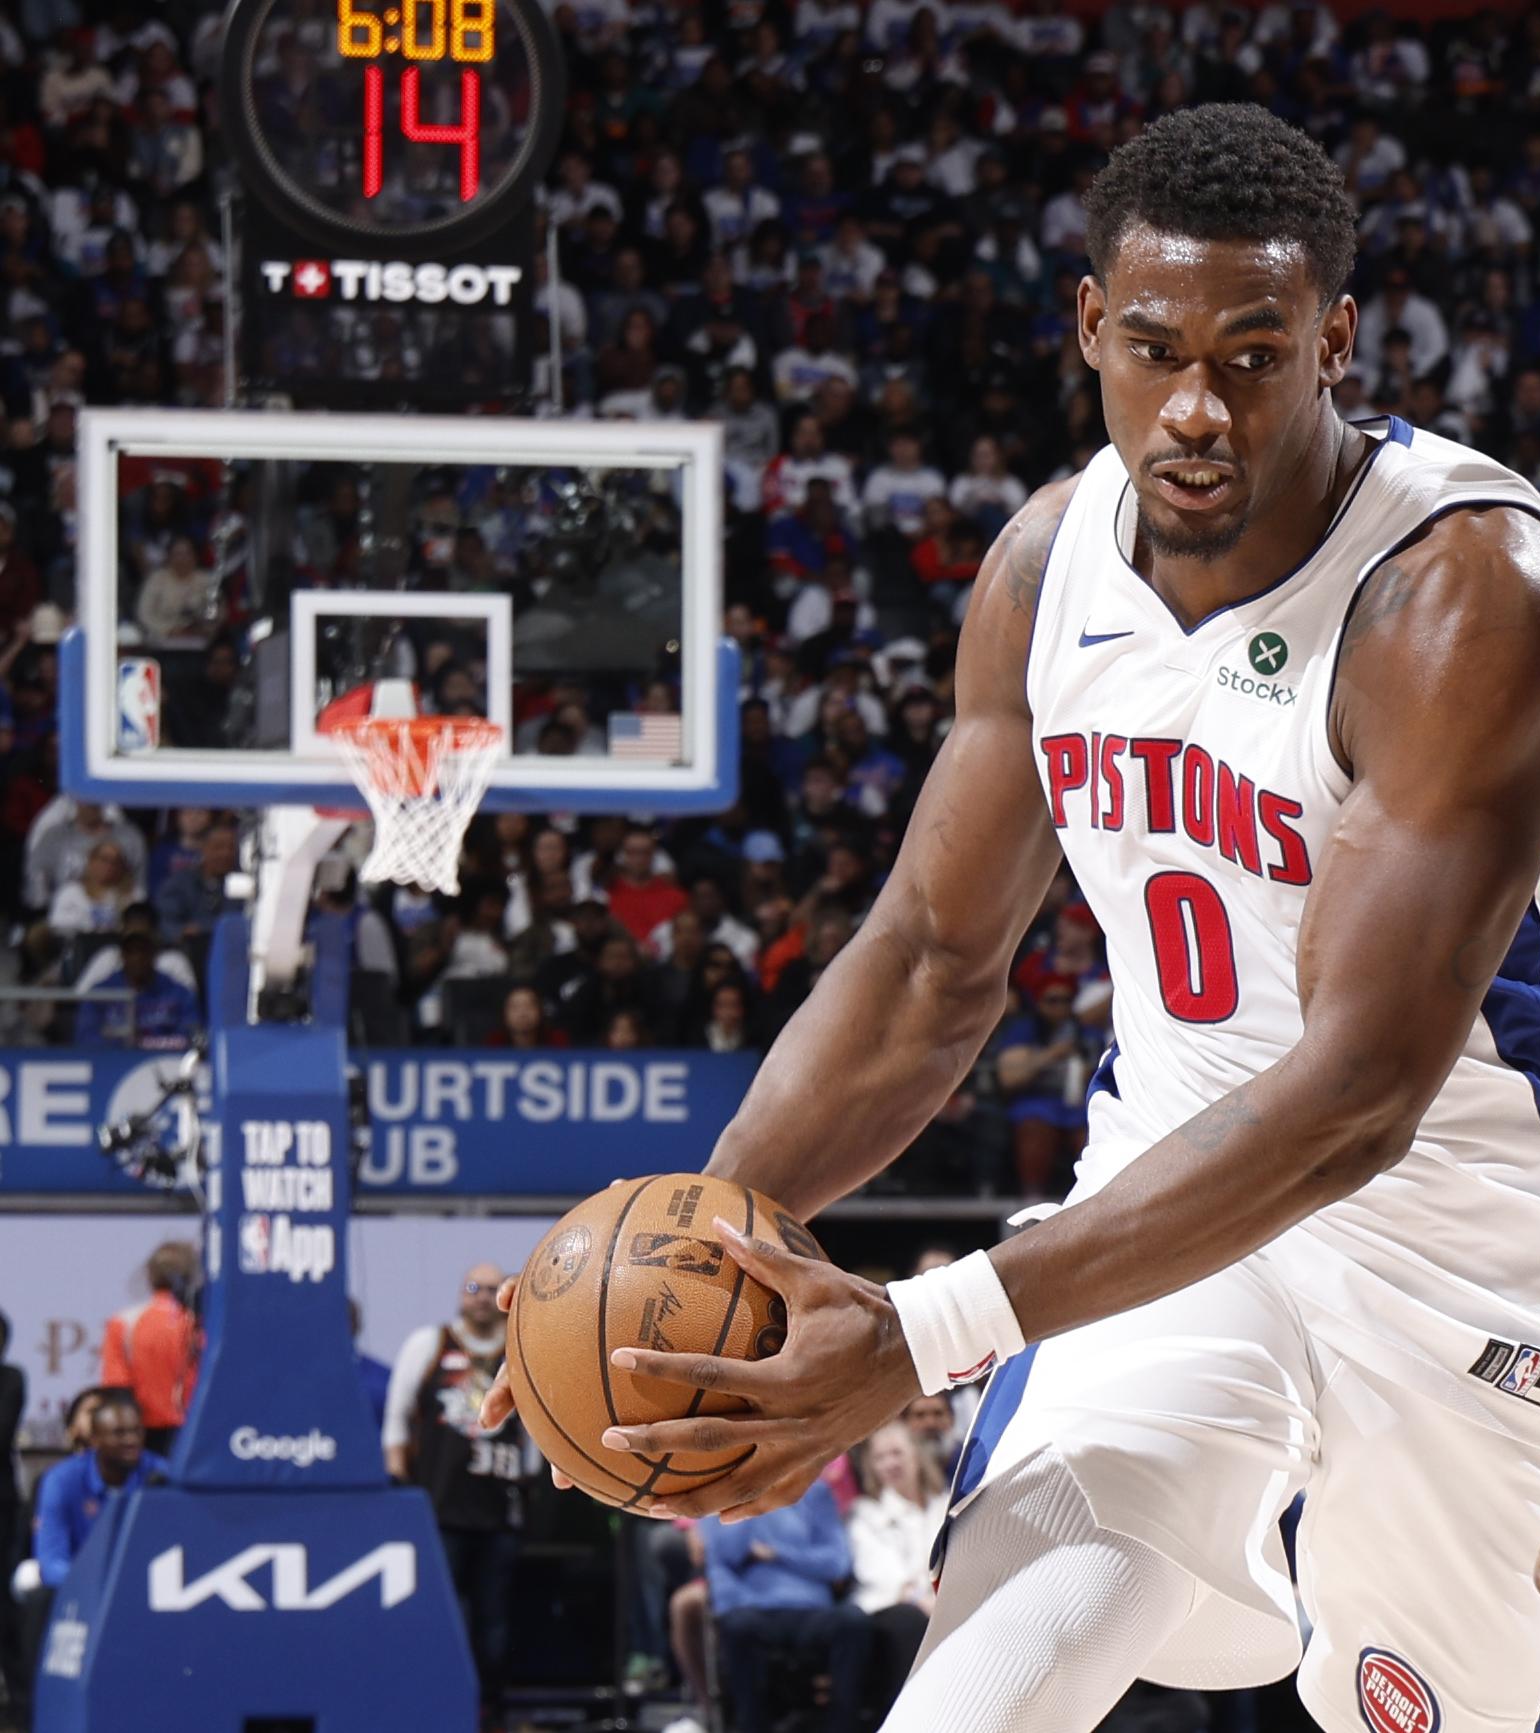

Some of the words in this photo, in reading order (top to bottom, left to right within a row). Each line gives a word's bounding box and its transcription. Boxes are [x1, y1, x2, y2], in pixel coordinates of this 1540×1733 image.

[337, 0, 494, 62] 6:08
[364, 64, 480, 201] 14
[331, 259, 521, 304] TISSOT
[1217, 666, 1297, 706] StockX
[1041, 732, 1313, 886] PISTONS
[1144, 871, 1239, 1024] 0
[242, 1120, 292, 1166] TAP
[295, 1120, 331, 1166] TO
[242, 1166, 333, 1211] WATCH
[269, 1213, 335, 1283] App
[229, 1425, 337, 1468] Google
[148, 1541, 416, 1612] KIA
[1366, 1677, 1416, 1733] PISTONS
[1370, 1666, 1422, 1721] DETROIT
